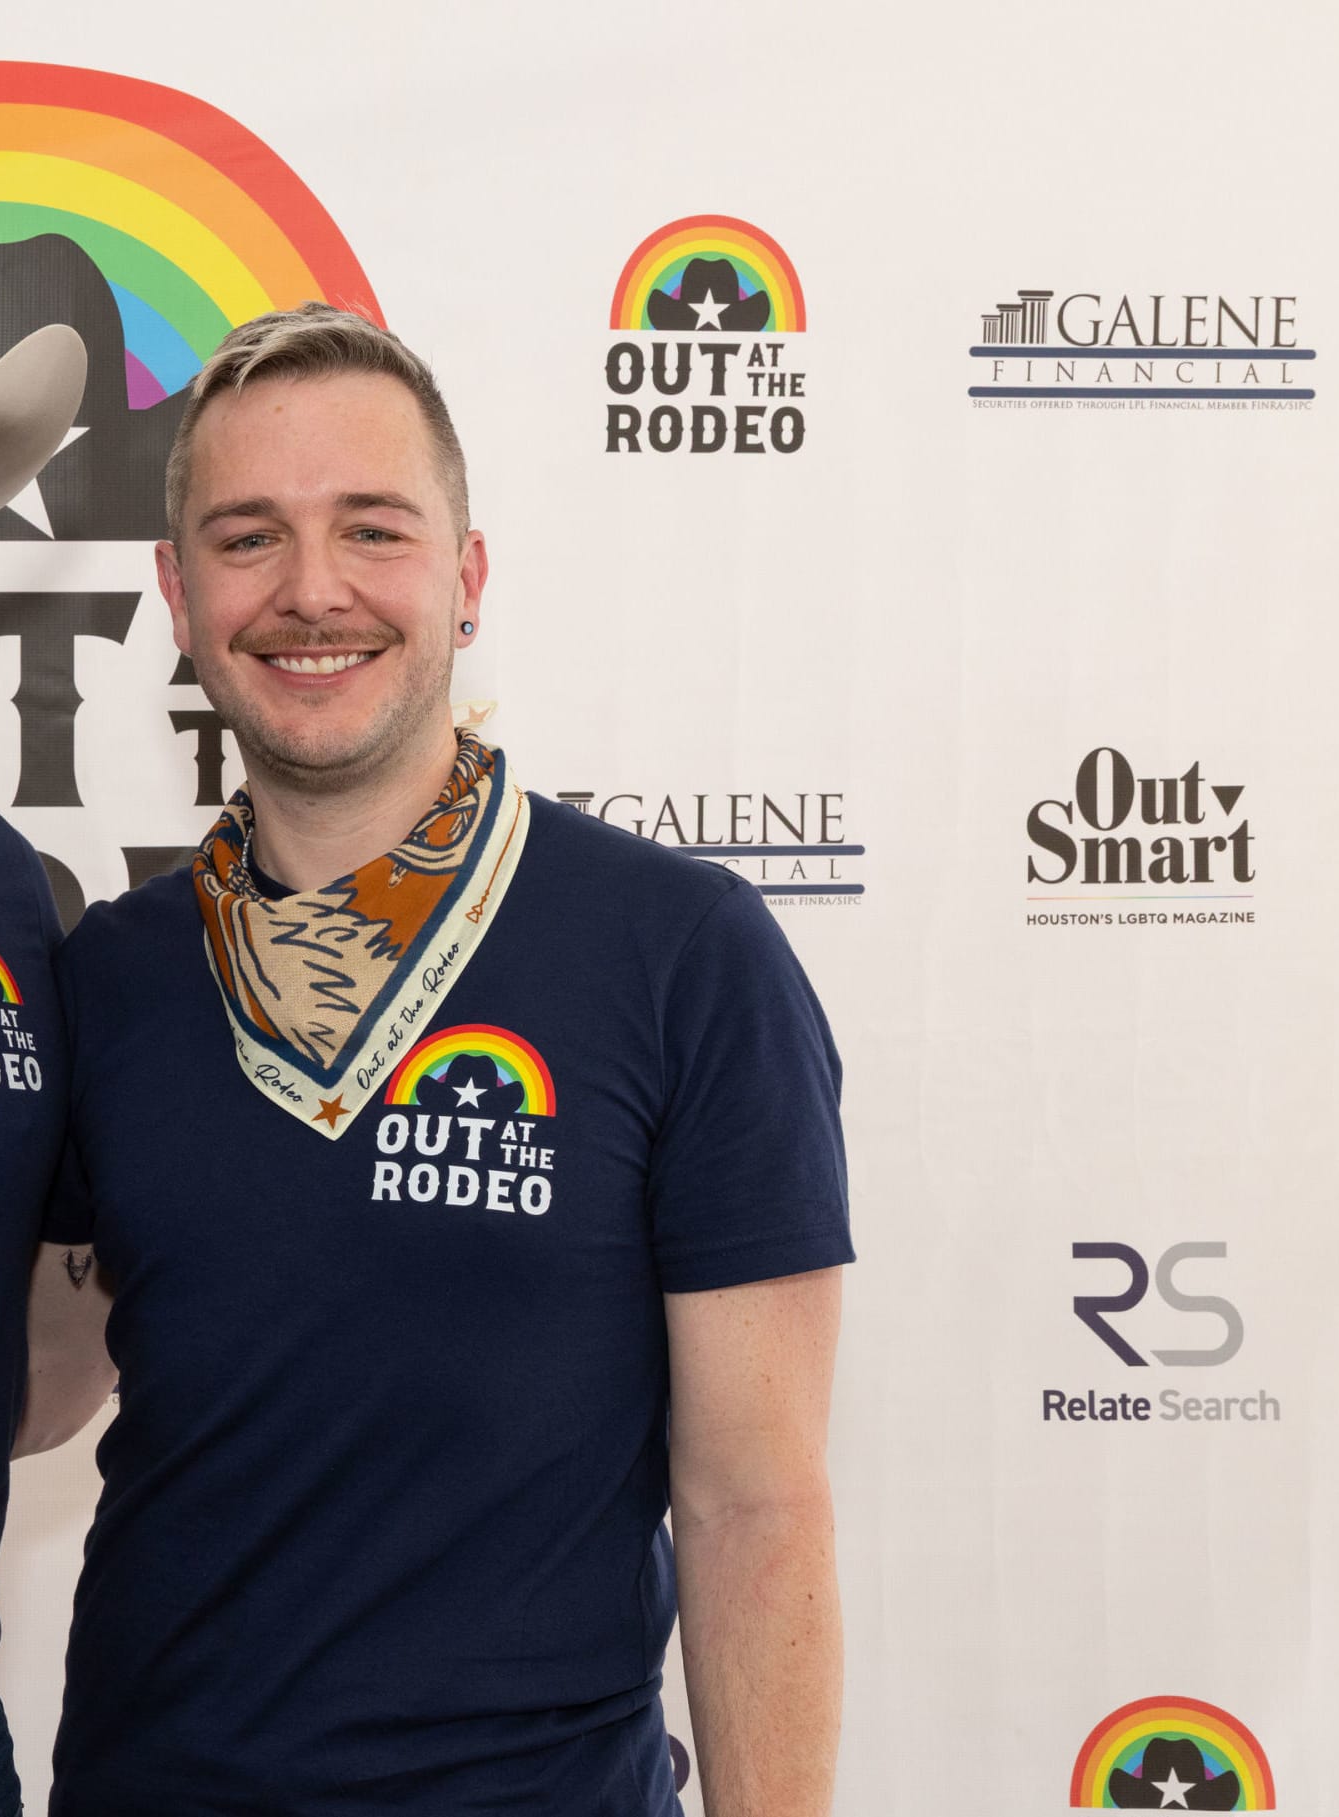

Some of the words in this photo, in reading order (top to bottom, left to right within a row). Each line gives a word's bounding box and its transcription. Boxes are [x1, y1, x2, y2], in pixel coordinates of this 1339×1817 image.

[1057, 293, 1298, 348] GALENE
[605, 342, 742, 396] OUT
[747, 343, 785, 367] AT
[747, 372, 806, 397] THE
[992, 360, 1294, 384] FINANCIAL
[1129, 400, 1145, 410] LPL
[1207, 401, 1248, 410] MEMBER
[605, 404, 806, 453] RODEO
[1075, 747, 1206, 831] Out
[1026, 800, 1256, 885] Smart
[1118, 913, 1168, 925] LGBTQ
[1173, 912, 1255, 924] MAGAZINE
[0, 1009, 18, 1028] AT
[357, 1051, 385, 1090] Out
[387, 1023, 404, 1051] at
[422, 942, 459, 994] Rodeo
[3, 1029, 37, 1051] THE
[254, 1064, 303, 1103] Rodeo
[376, 1113, 496, 1161] OUT
[500, 1120, 536, 1143] AT
[500, 1143, 555, 1171] THE
[371, 1161, 553, 1216] RODEO
[1072, 1241, 1244, 1367] RS
[1043, 1389, 1151, 1422] Relate
[1159, 1389, 1281, 1422] Search
